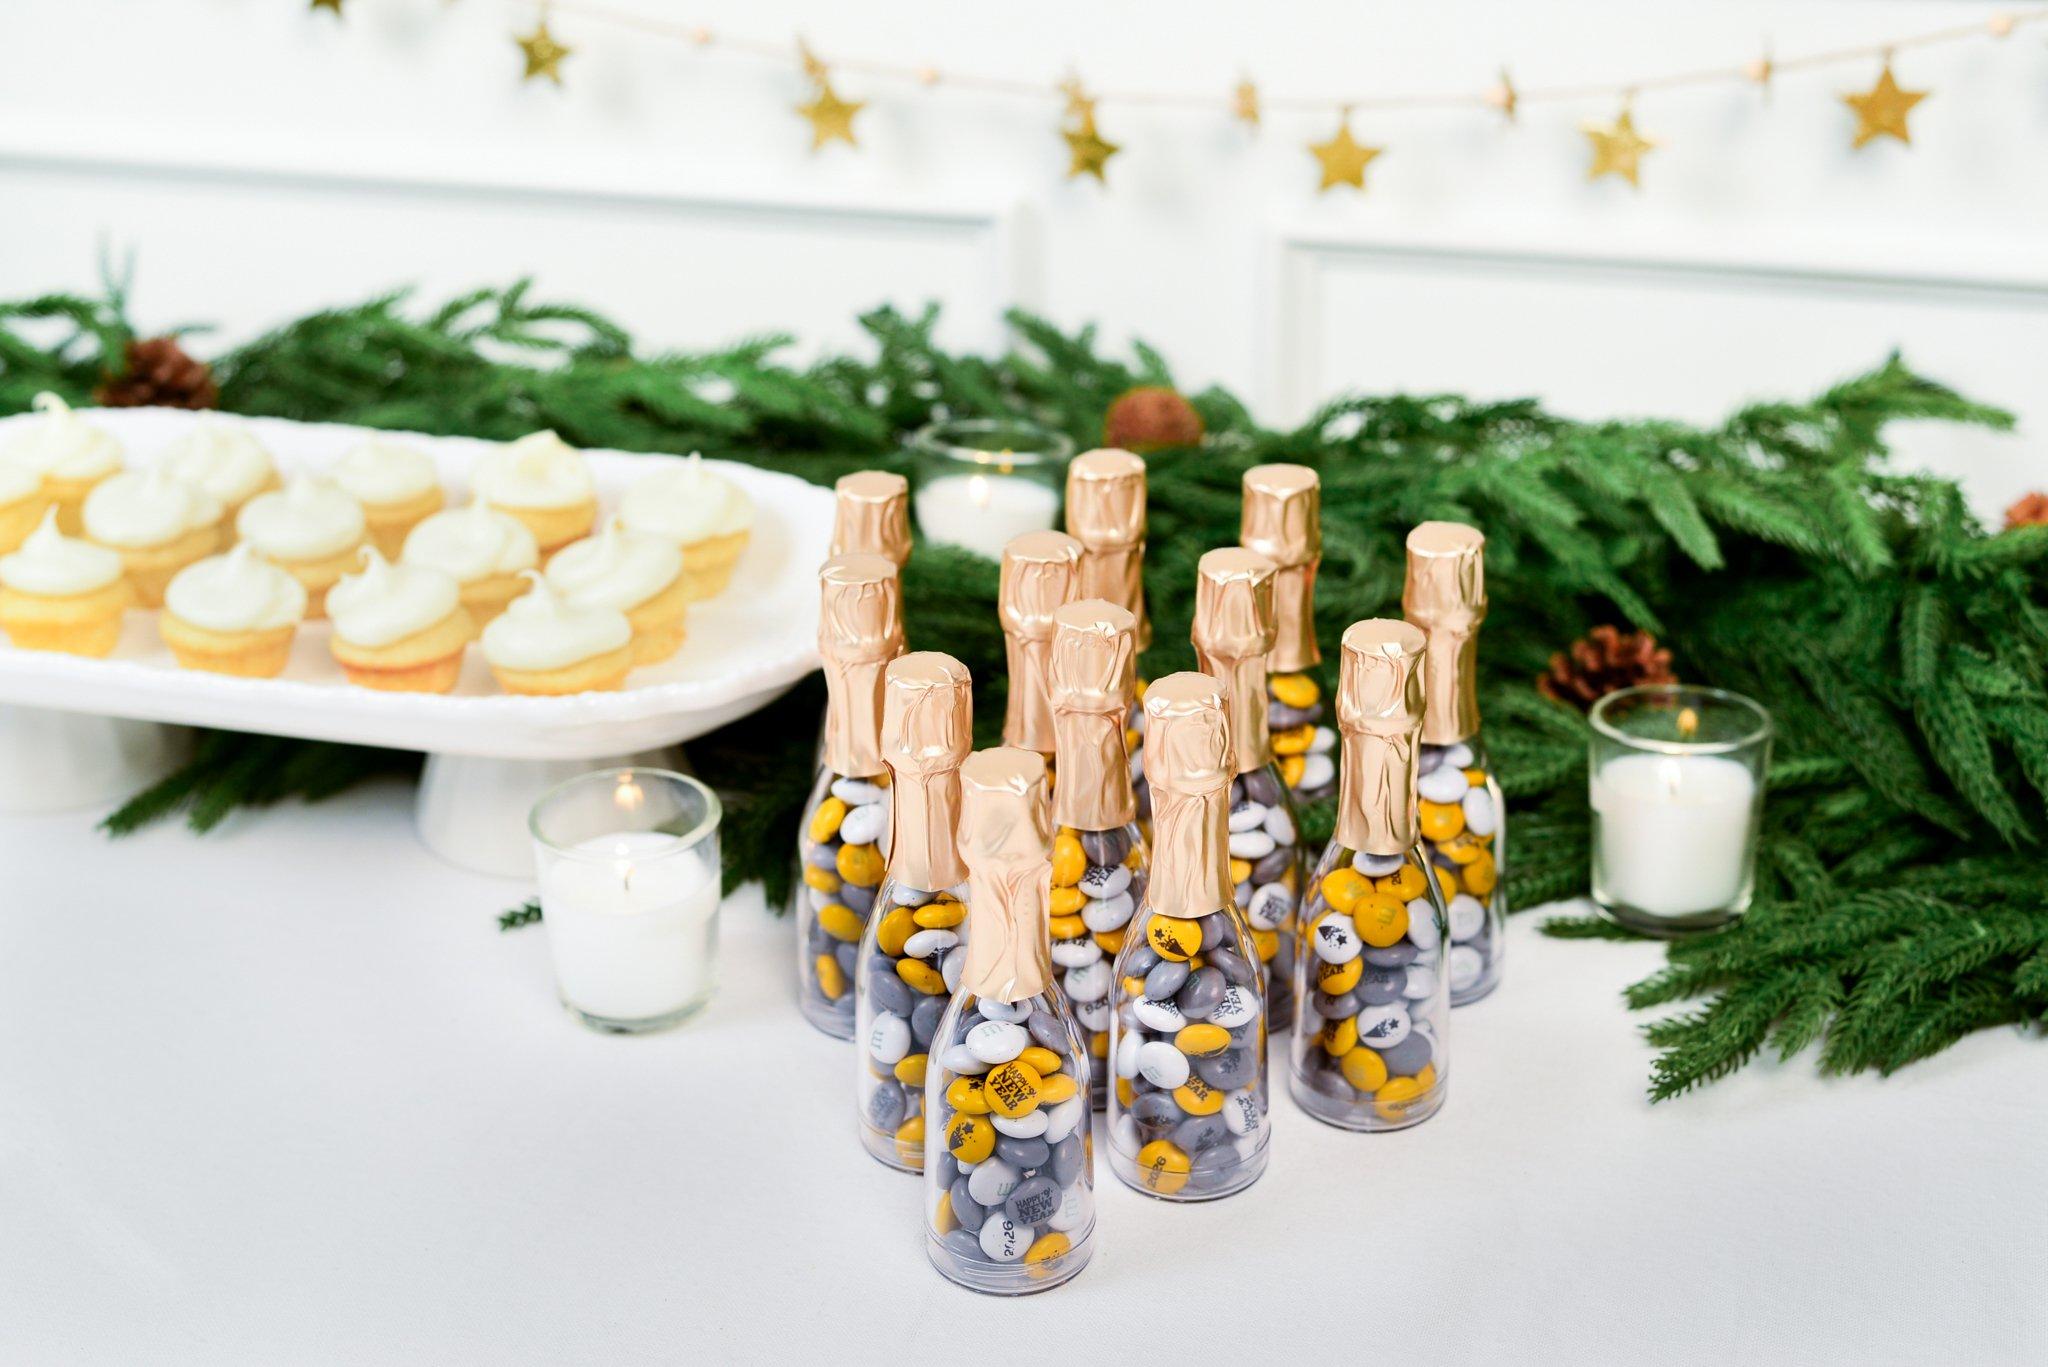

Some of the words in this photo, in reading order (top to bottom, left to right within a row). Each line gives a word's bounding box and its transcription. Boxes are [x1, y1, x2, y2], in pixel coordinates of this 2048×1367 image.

[997, 1069, 1029, 1102] NEW
[1005, 1062, 1029, 1089] HAPPY
[1186, 1079, 1208, 1101] EAR
[989, 1076, 1018, 1110] YEAR
[1147, 1155, 1167, 1188] 2026
[1015, 1194, 1040, 1209] HAPPY
[1018, 1197, 1053, 1219] NEW
[1002, 1220, 1015, 1257] 2026
